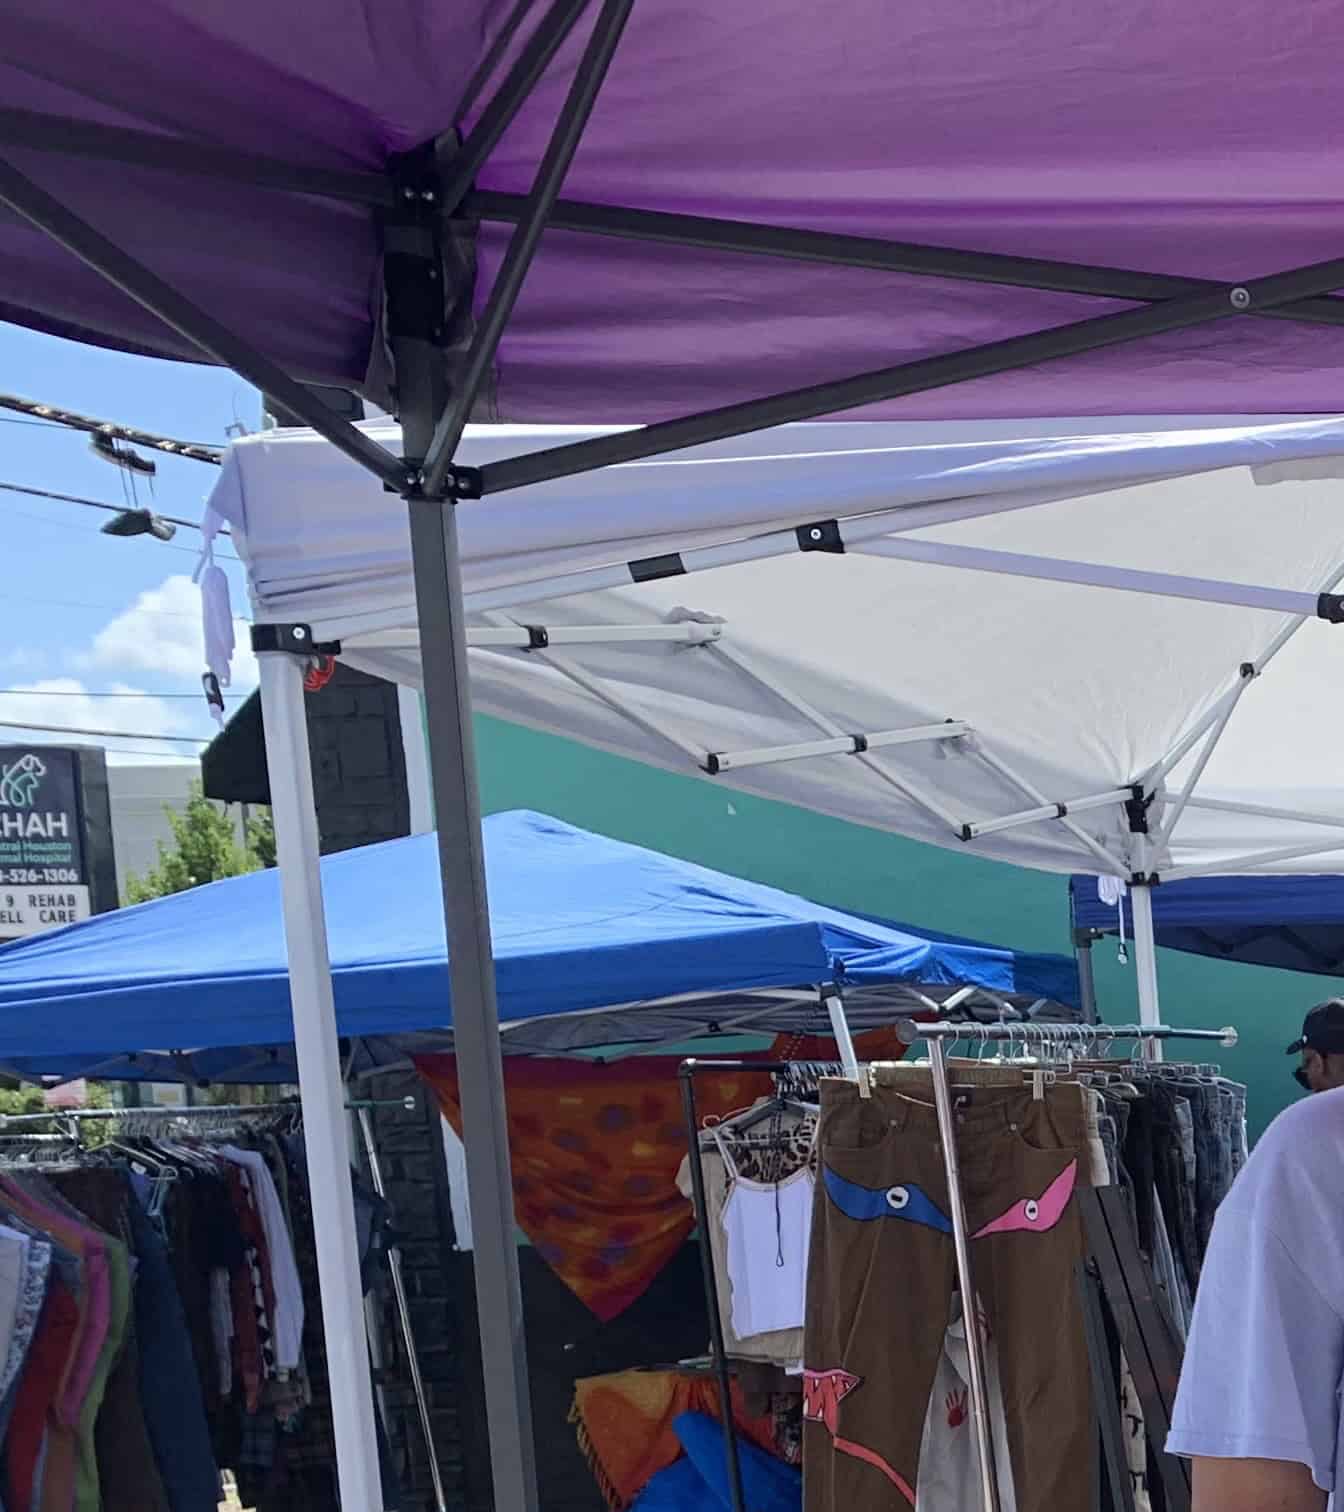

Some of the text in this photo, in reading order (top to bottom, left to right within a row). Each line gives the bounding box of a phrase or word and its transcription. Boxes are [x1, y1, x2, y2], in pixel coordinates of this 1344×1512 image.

[0, 812, 68, 837] HAH
[28, 894, 76, 907] REHAB
[39, 909, 76, 923] CARE
